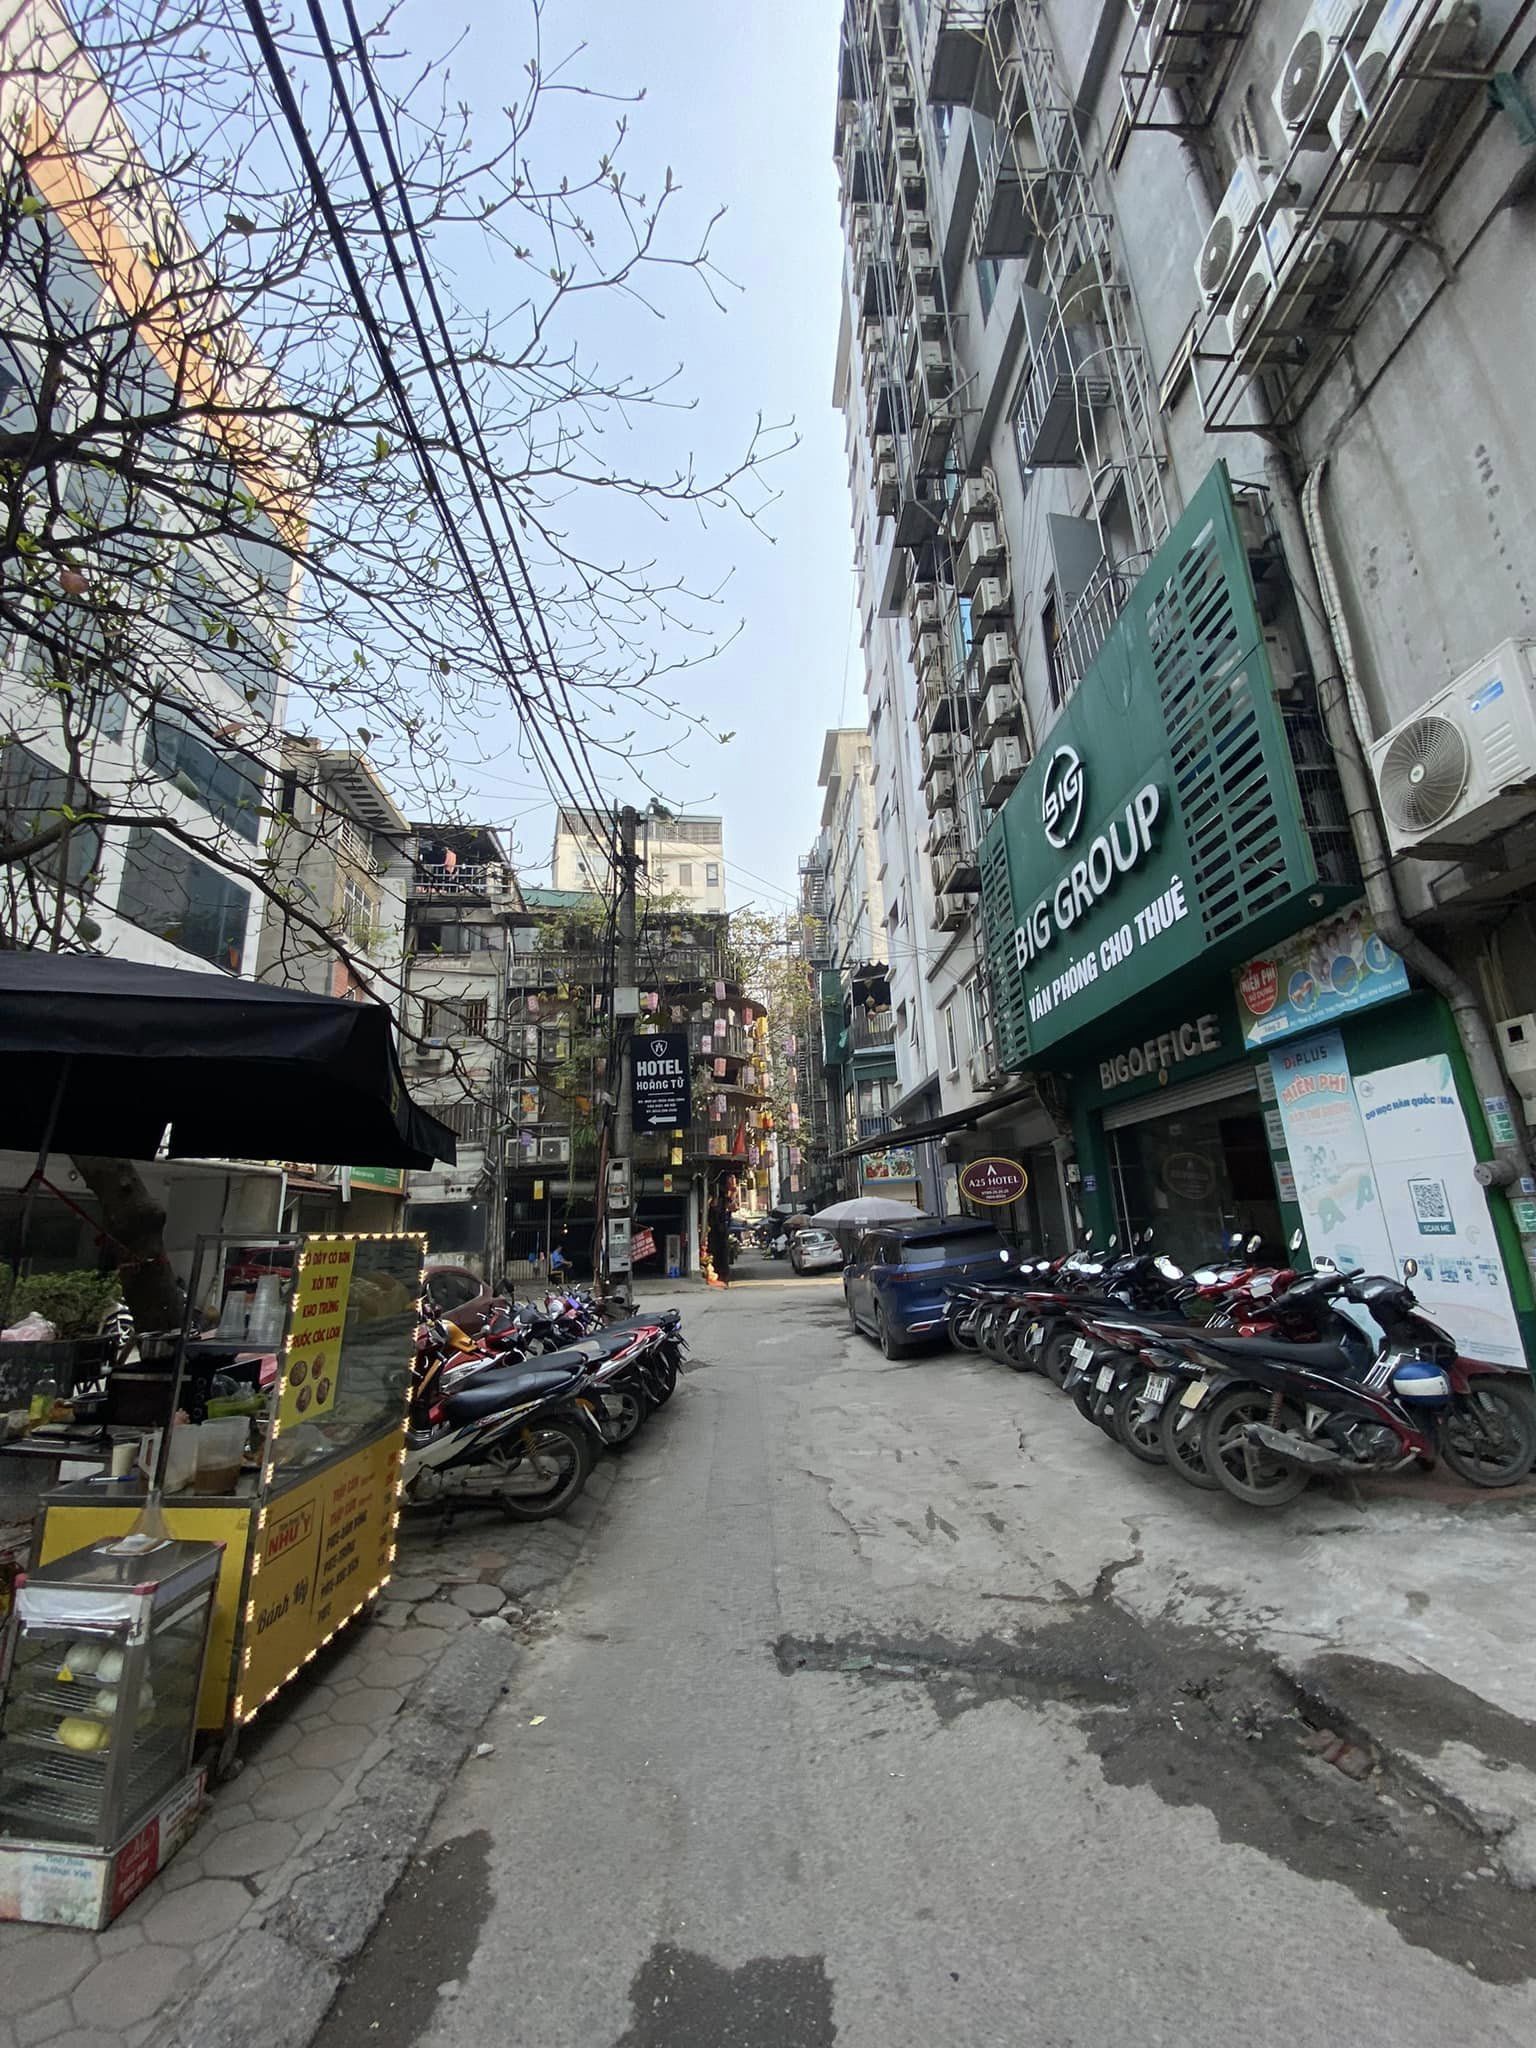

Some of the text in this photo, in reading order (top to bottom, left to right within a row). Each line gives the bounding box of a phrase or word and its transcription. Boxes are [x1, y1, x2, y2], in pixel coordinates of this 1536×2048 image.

[1045, 770, 1079, 822] BIG
[1014, 783, 1160, 971] BIG GROUP
[1028, 874, 1189, 1023] VĂN PHÒNG CHO THUÊ
[637, 1059, 683, 1076] HOTEL
[1100, 1014, 1221, 1090] BIGOFFICE
[636, 1077, 684, 1091] HOÀNG TỬ
[1281, 1074, 1316, 1104] MIỄN
[1318, 1072, 1348, 1093] PHÍ
[969, 1176, 1019, 1187] A25 HOTEL
[1423, 1224, 1440, 1233] SCAN
[257, 1594, 289, 1636] Bánh
